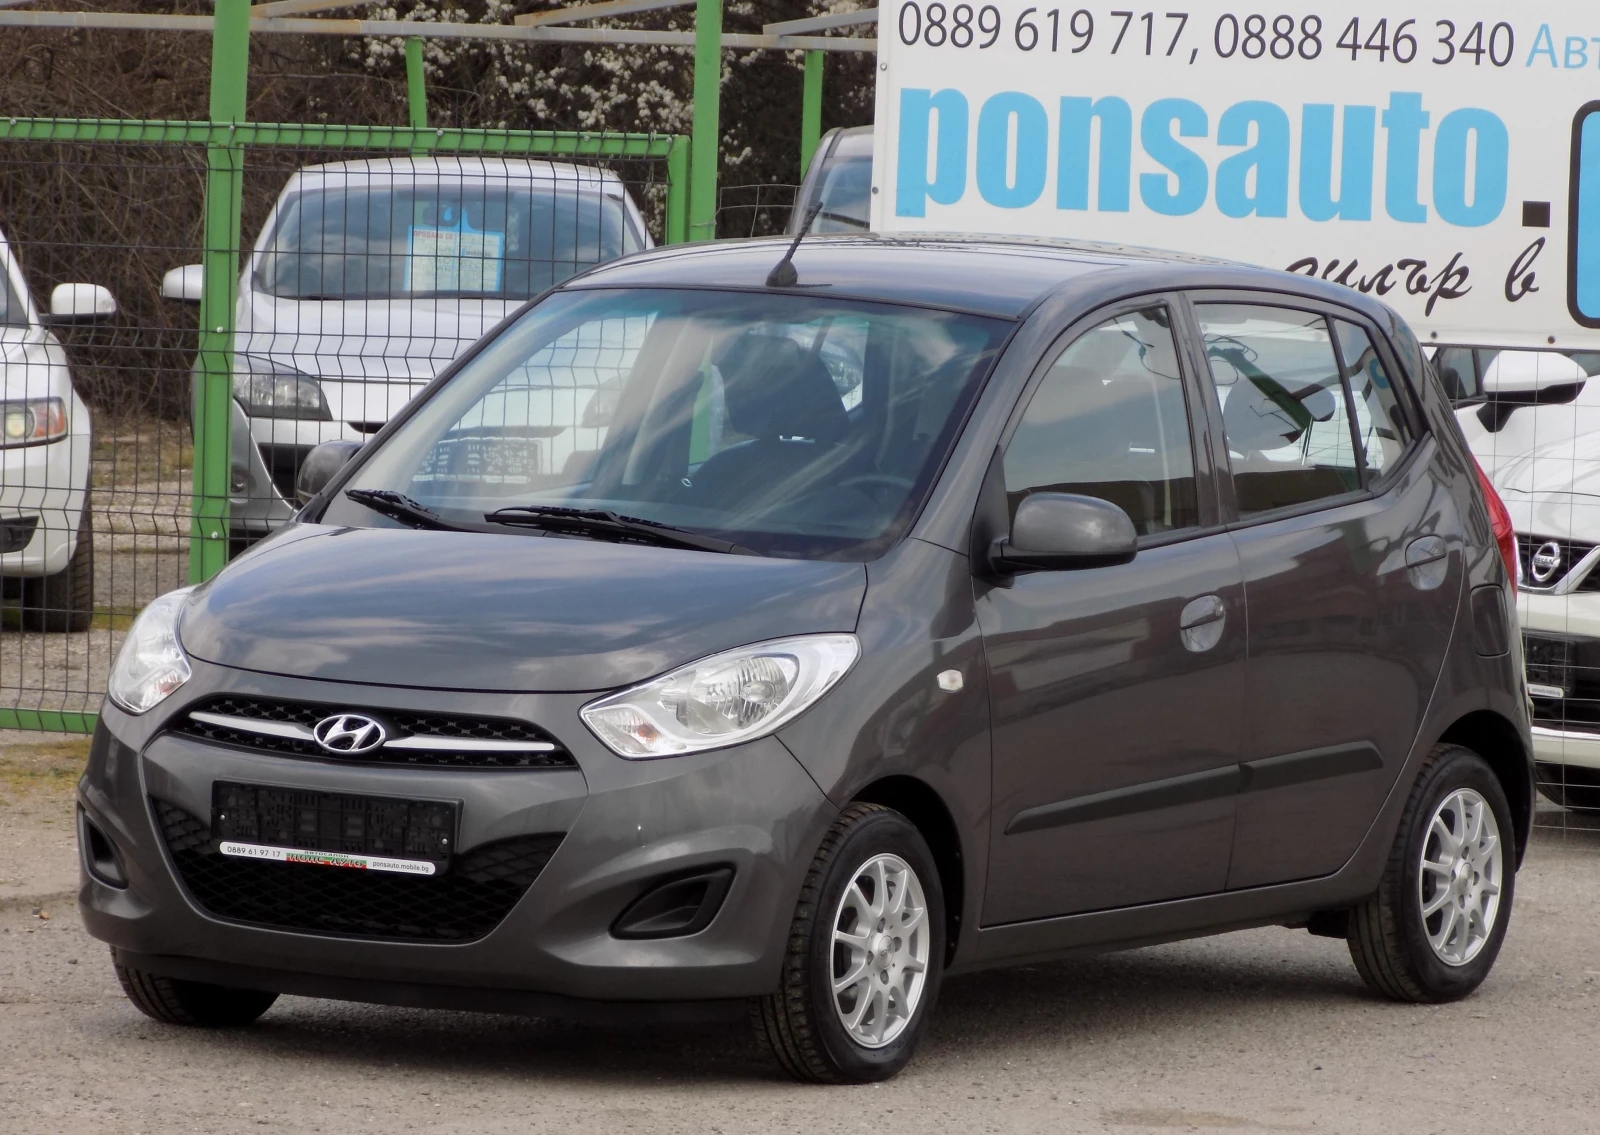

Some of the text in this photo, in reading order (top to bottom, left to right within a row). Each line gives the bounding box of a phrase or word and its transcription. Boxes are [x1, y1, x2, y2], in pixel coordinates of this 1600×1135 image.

[898, 1, 1001, 50] 0889
[1014, 7, 1094, 54] 619
[1110, 10, 1199, 65] 717,
[1213, 13, 1323, 61] 0888
[1335, 16, 1418, 64] 446
[1431, 19, 1515, 68] 340
[413, 230, 443, 239] ПРОДАА
[227, 845, 246, 854] 0889
[272, 850, 281, 858] 17
[372, 861, 430, 873] ponsauto.mobile.bg
